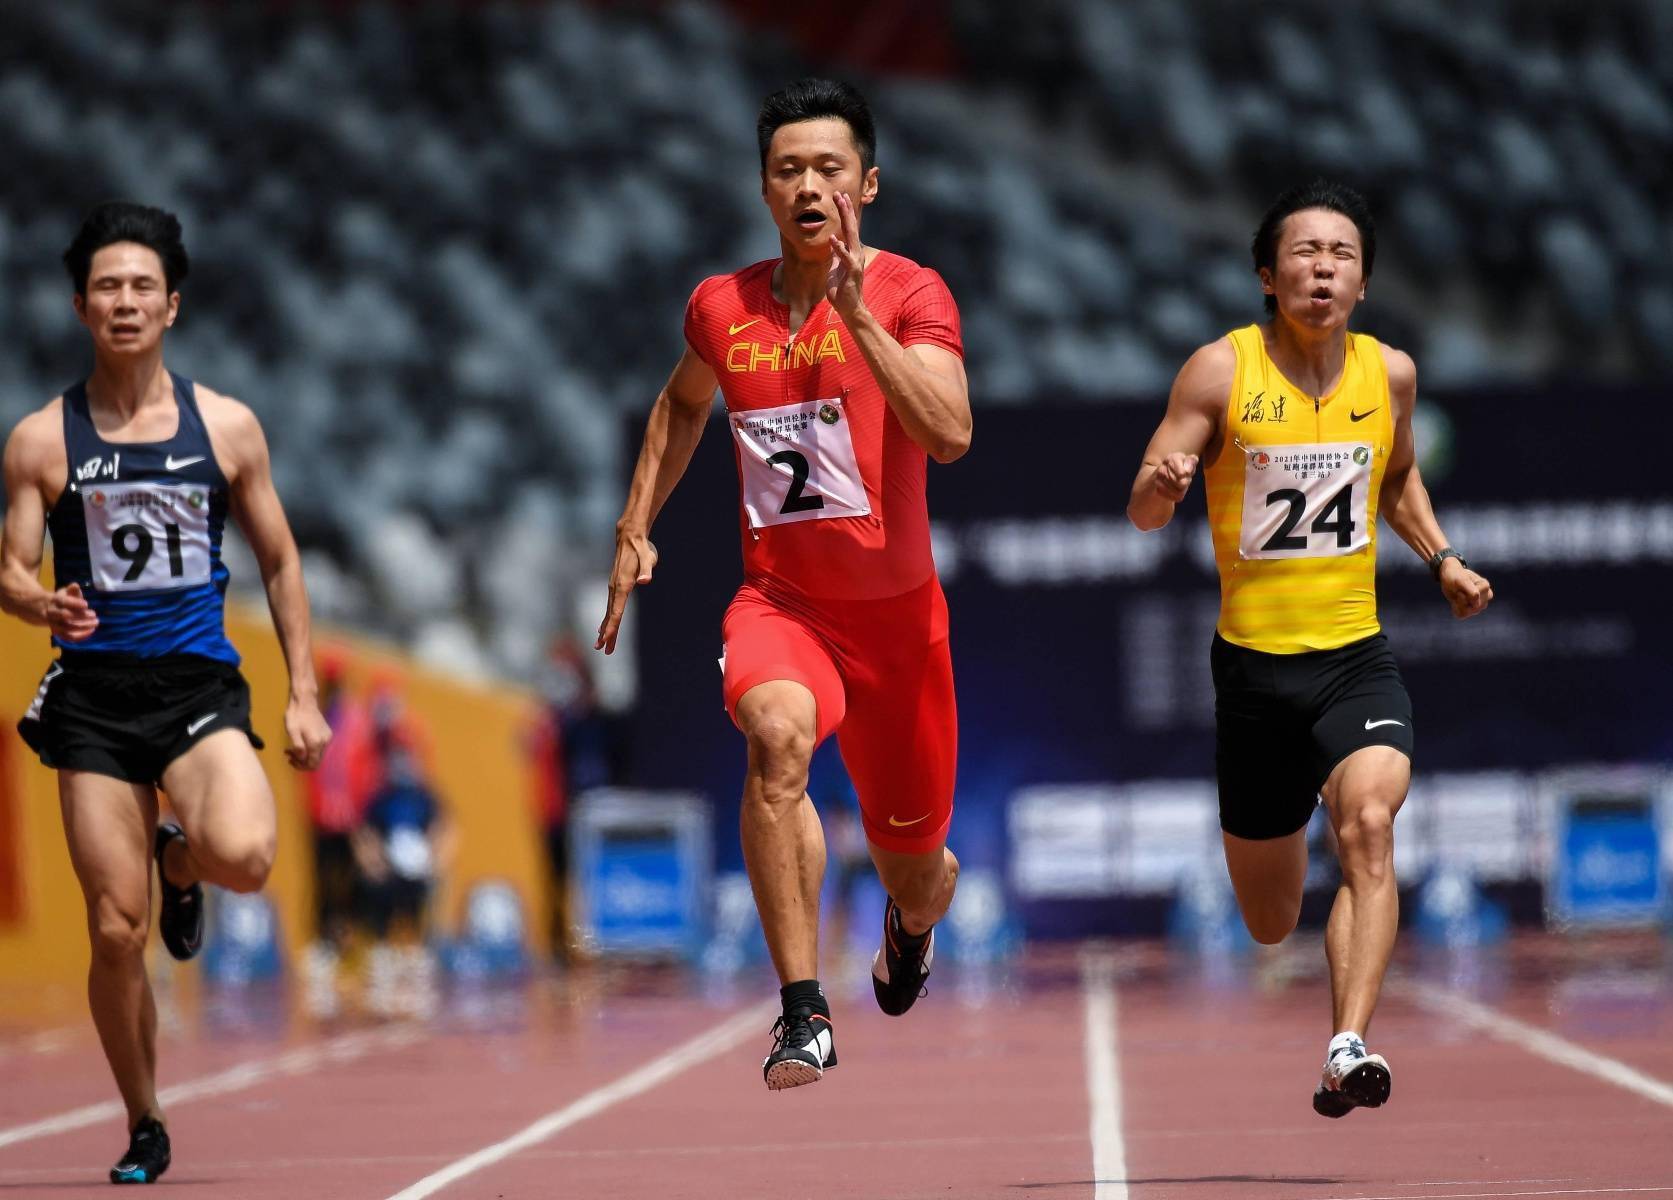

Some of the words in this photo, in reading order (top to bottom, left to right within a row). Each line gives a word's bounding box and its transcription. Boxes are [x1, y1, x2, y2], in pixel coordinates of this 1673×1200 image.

[727, 329, 846, 372] CHINA
[1241, 391, 1288, 423] 福建
[76, 452, 120, 481] 四川
[1274, 452, 1349, 463] 2021年中国田径协会
[766, 450, 824, 514] 2
[1260, 483, 1356, 551] 24
[111, 523, 184, 583] 91
